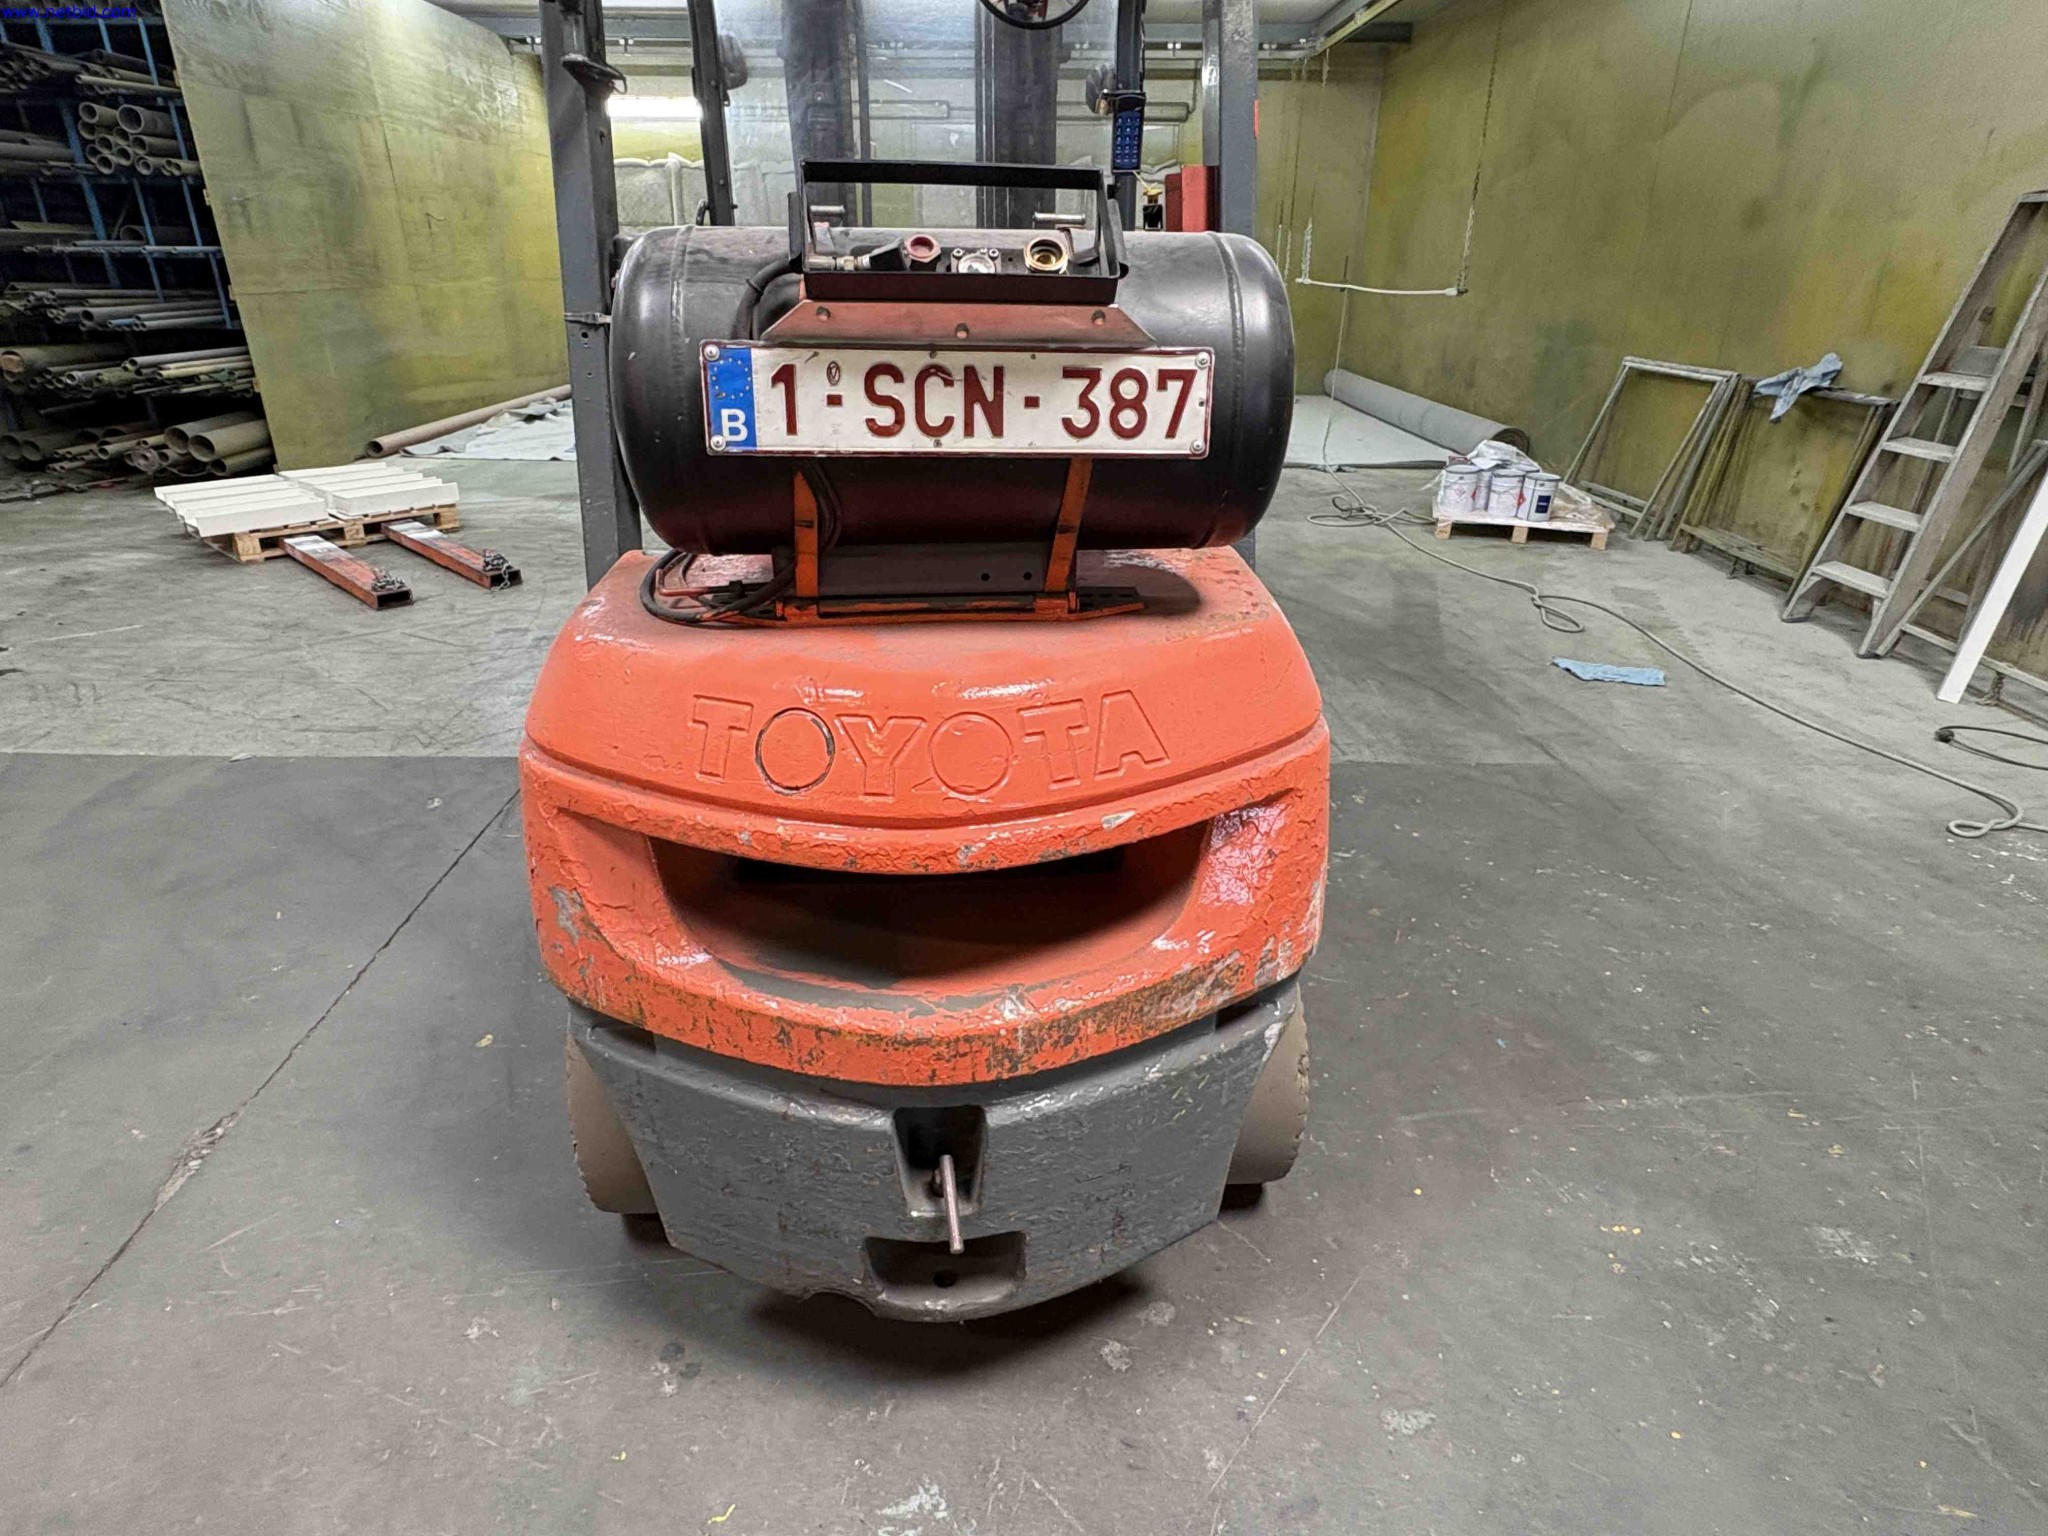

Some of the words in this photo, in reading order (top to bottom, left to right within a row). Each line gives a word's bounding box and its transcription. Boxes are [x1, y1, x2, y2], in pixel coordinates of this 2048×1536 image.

[721, 408, 748, 442] B
[770, 363, 1198, 440] 1-SCN-387
[688, 689, 1170, 801] TOYOTA
